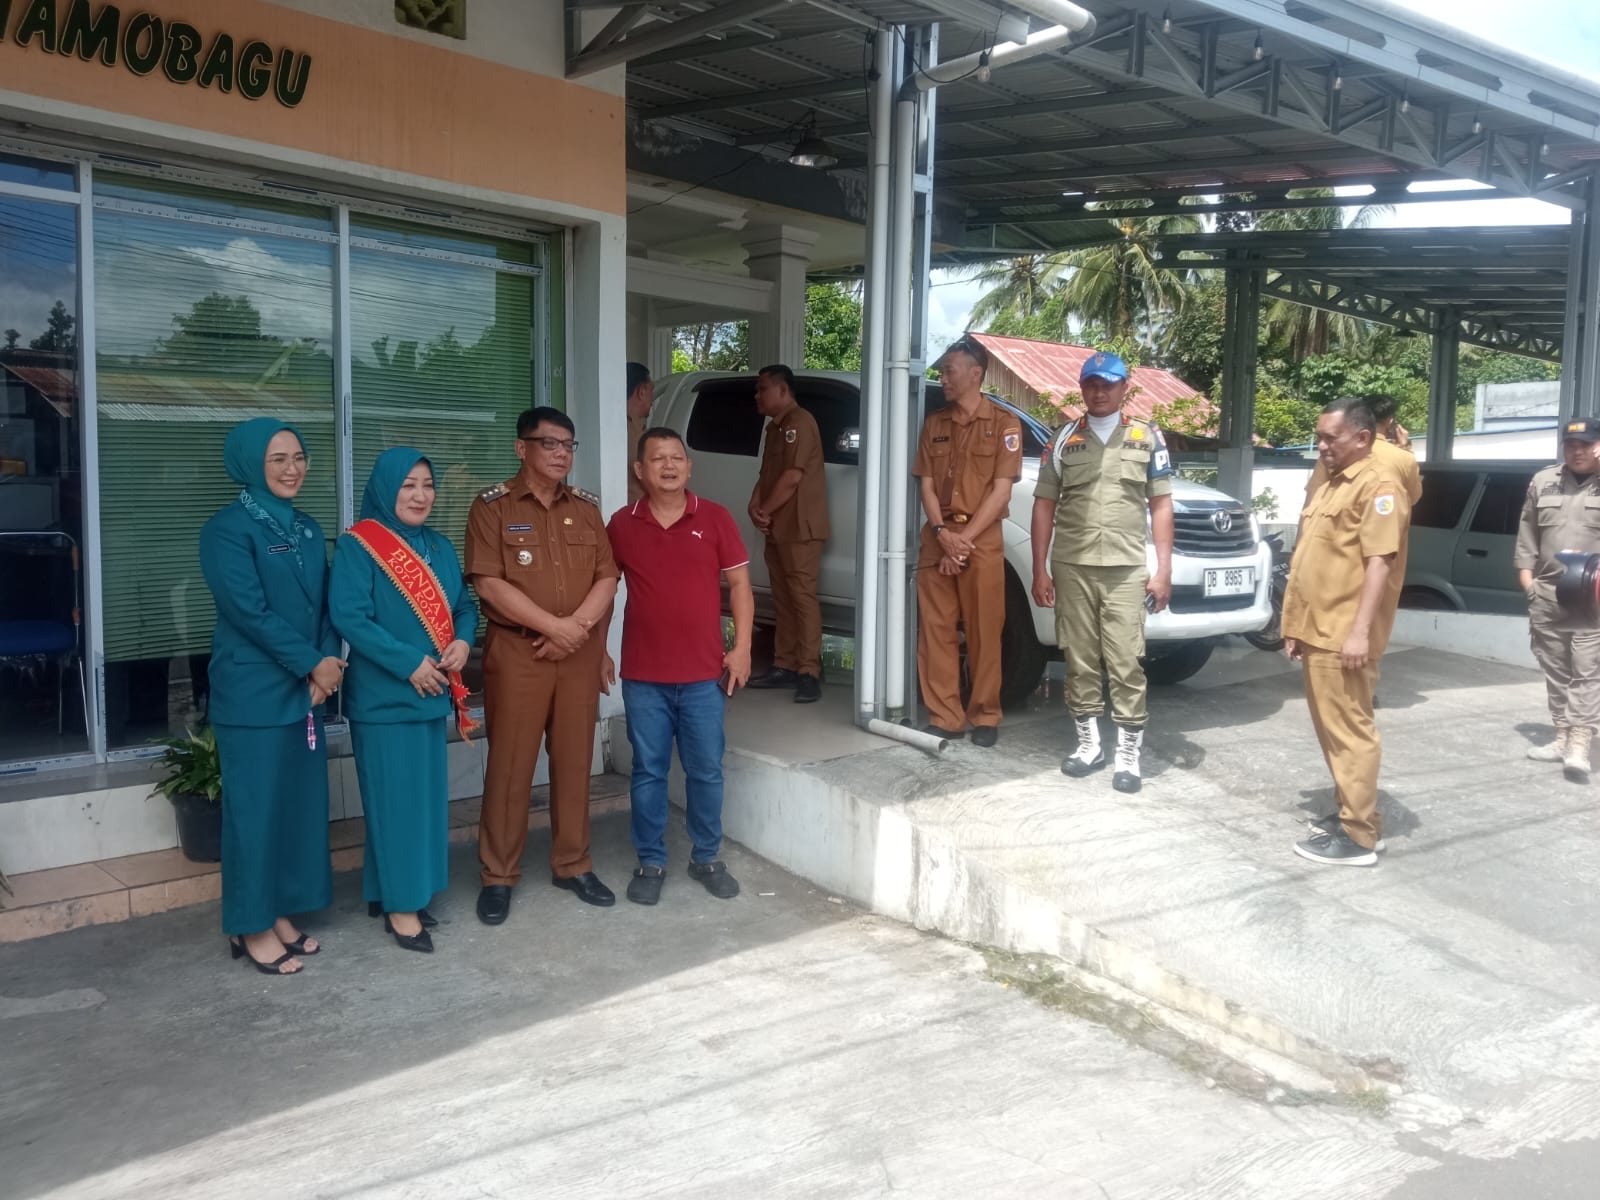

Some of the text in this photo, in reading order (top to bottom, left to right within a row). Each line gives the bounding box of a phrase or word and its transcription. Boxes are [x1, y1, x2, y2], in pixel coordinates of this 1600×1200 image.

[387, 558, 448, 648] KOTA KOTAMOB
[390, 549, 441, 616] BUNDA
[1208, 571, 1216, 587] DB
[1224, 569, 1243, 586] 8965
